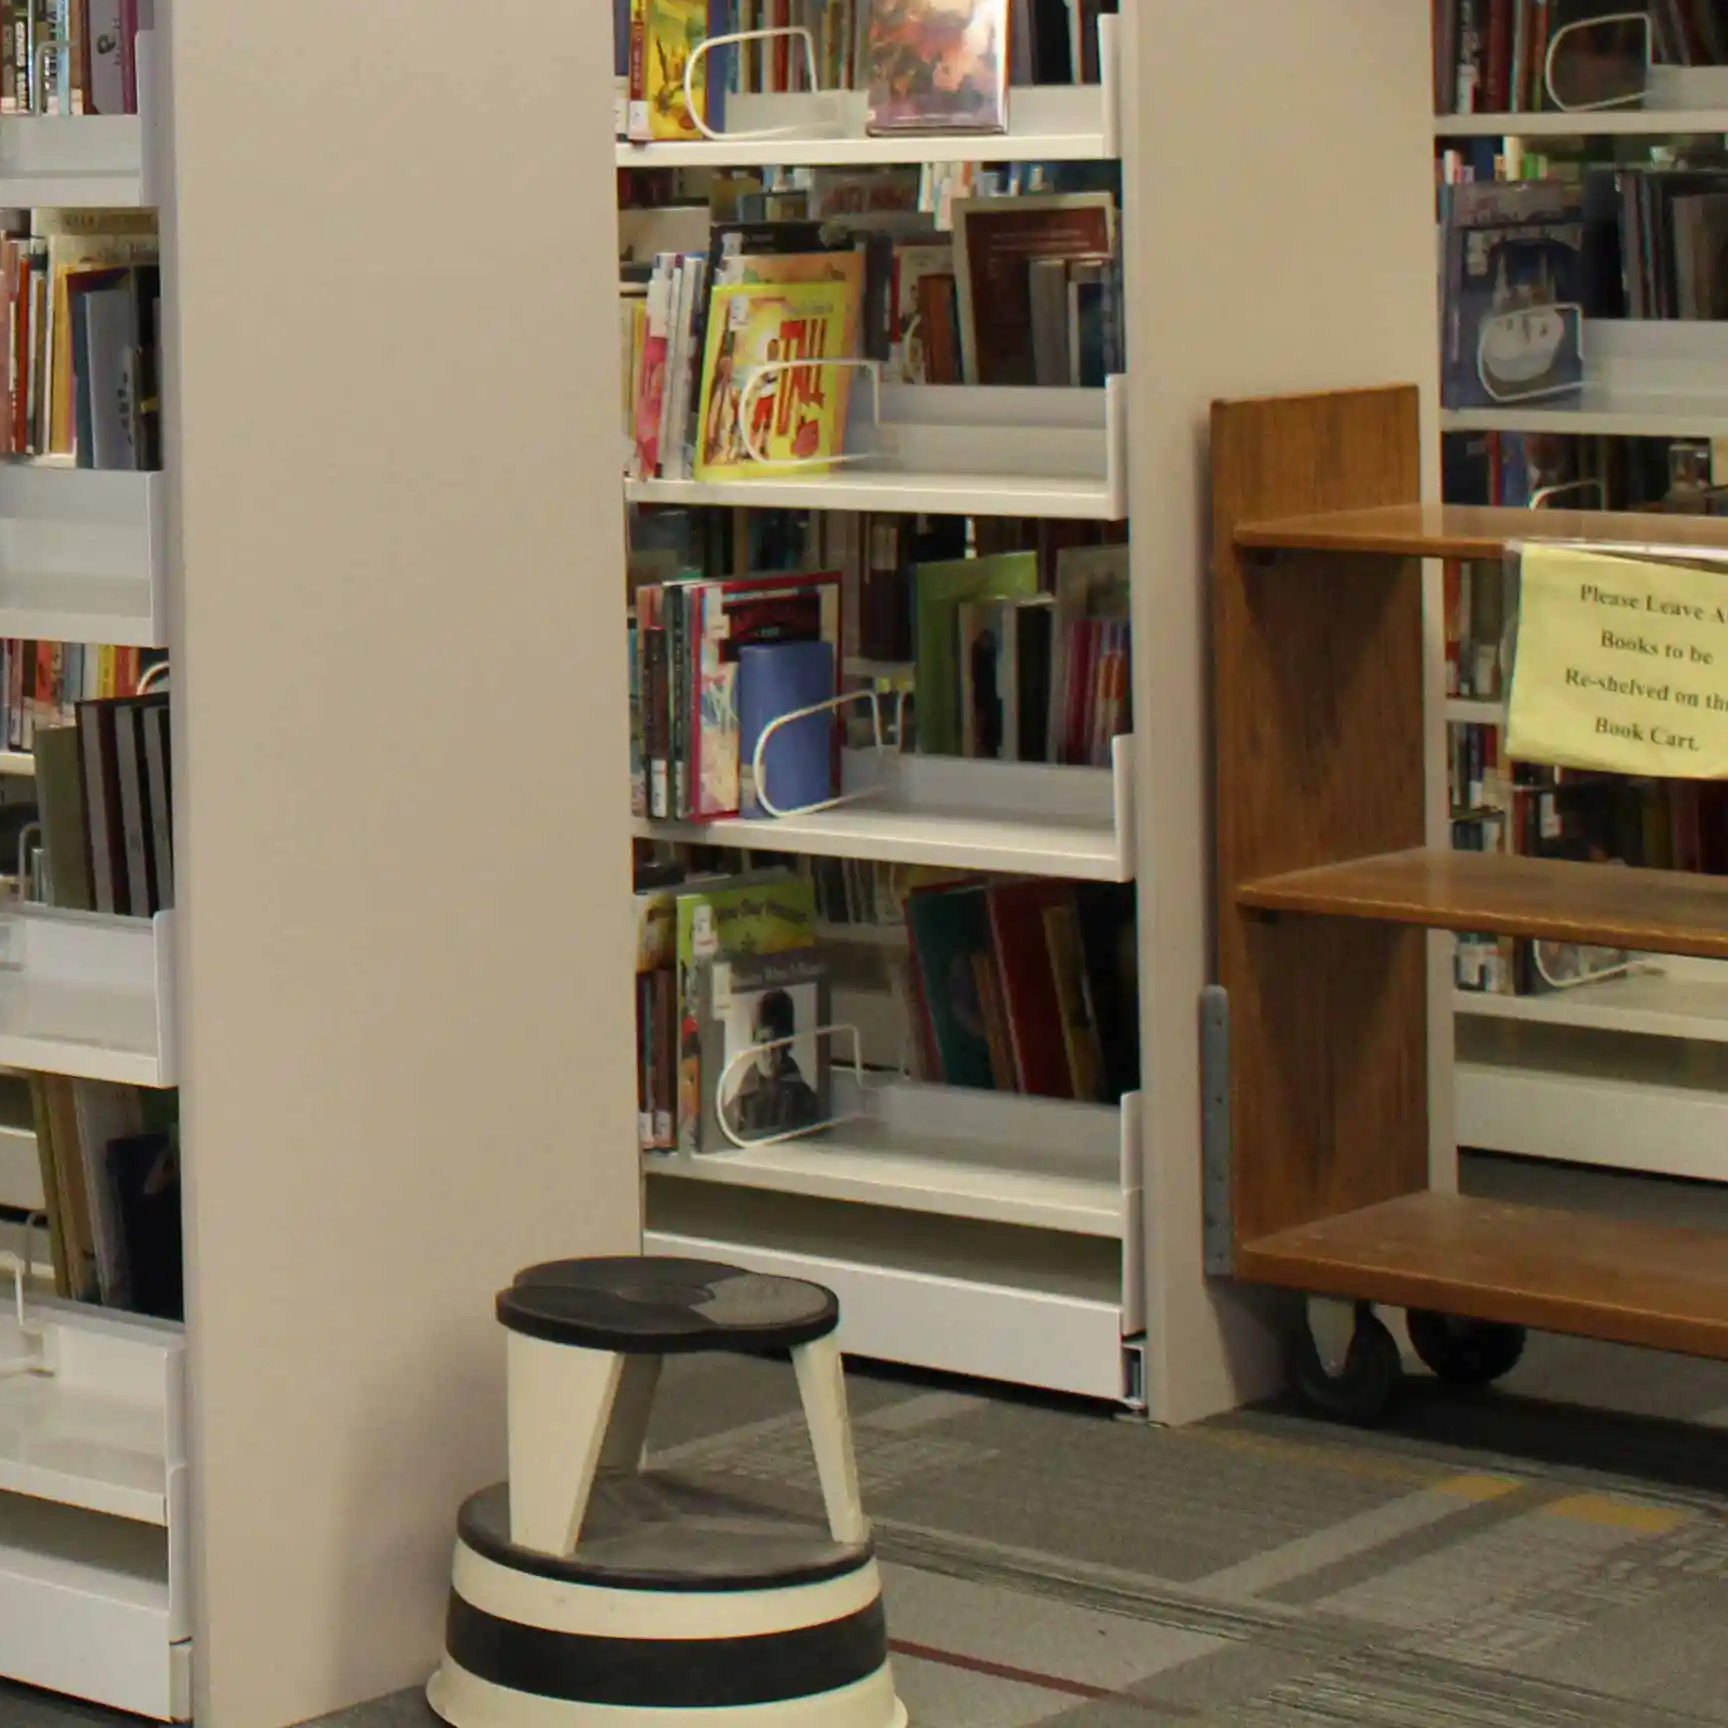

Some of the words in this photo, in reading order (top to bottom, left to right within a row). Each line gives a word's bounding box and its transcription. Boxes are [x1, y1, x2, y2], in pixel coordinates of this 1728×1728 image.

[1580, 583, 1639, 610] Please
[1645, 592, 1704, 621] Leave
[1601, 630, 1659, 657] Books
[1664, 642, 1684, 659] to
[1689, 645, 1713, 665] be
[1565, 668, 1669, 702] Re-shelved
[1675, 689, 1699, 708] on
[1594, 717, 1645, 742] Book
[1649, 726, 1699, 752] Cart.
